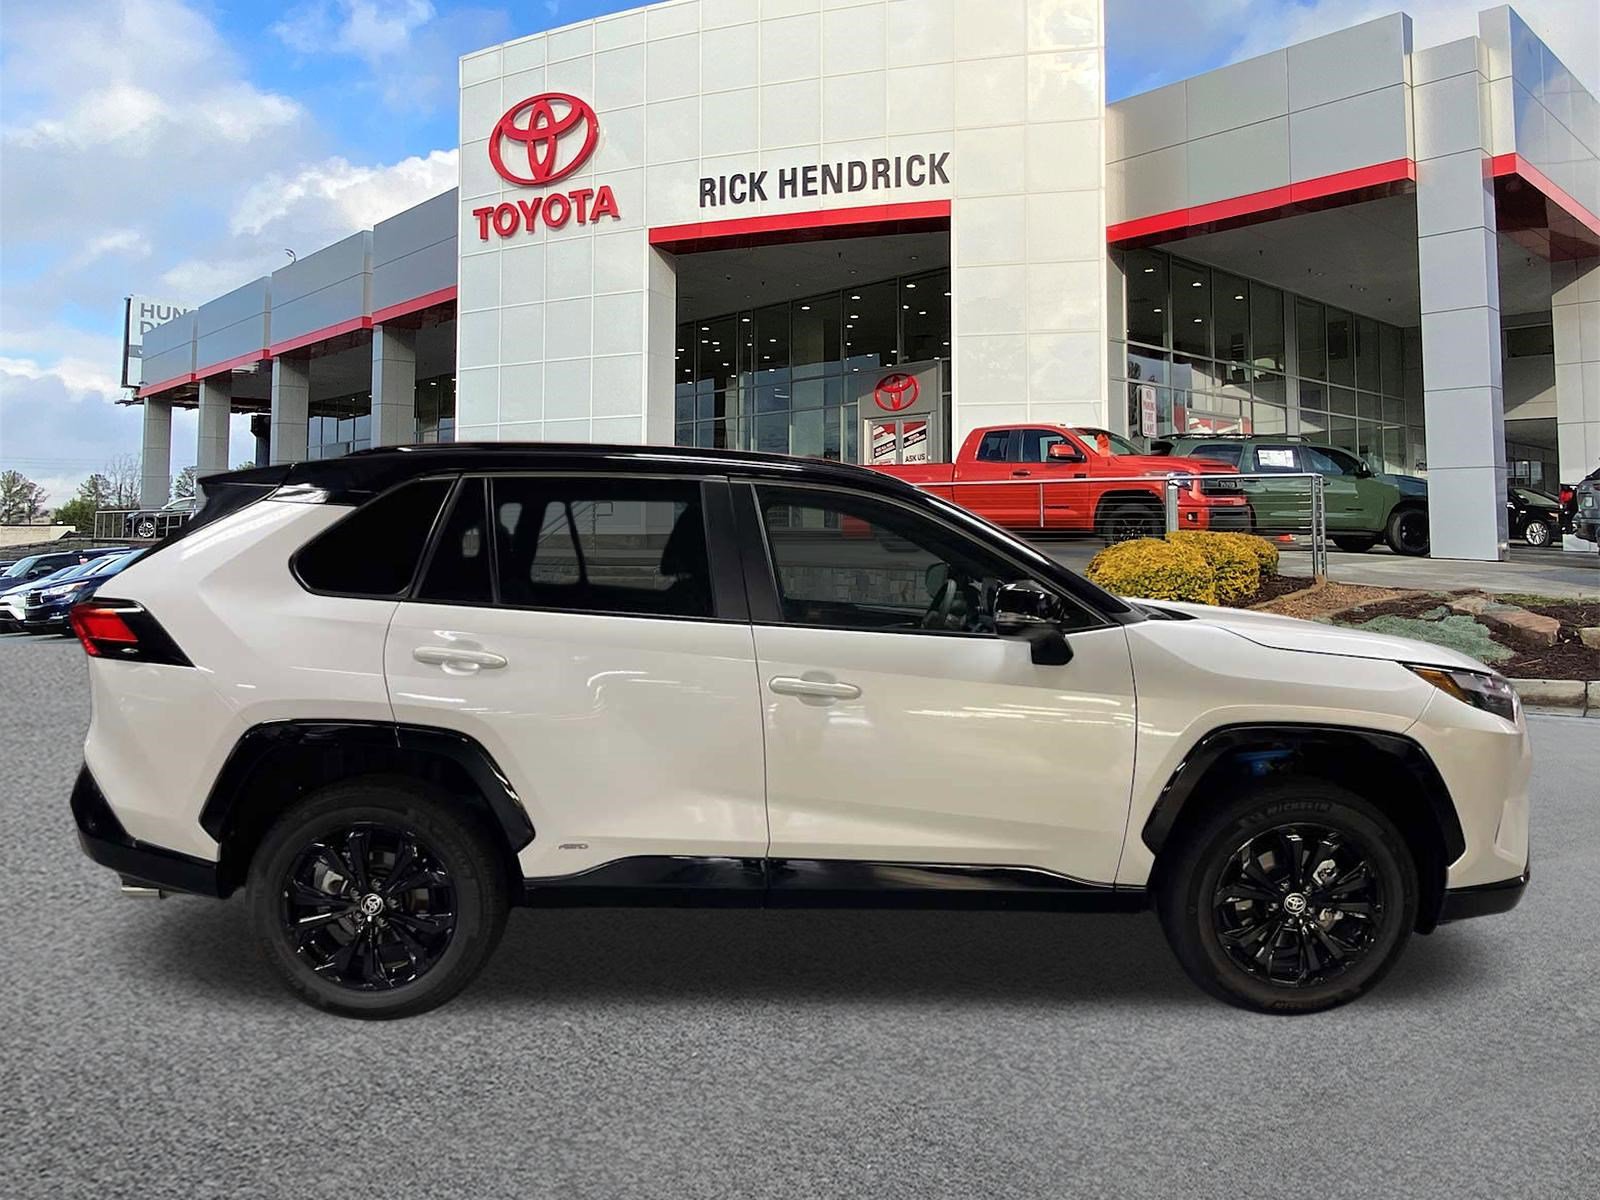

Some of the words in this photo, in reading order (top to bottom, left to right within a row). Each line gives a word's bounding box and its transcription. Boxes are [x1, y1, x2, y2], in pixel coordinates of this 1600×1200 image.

[699, 170, 768, 208] RICK
[778, 152, 950, 199] HENDRICK
[472, 185, 620, 240] TOYOTA
[904, 455, 917, 463] ASK
[918, 453, 926, 461] US
